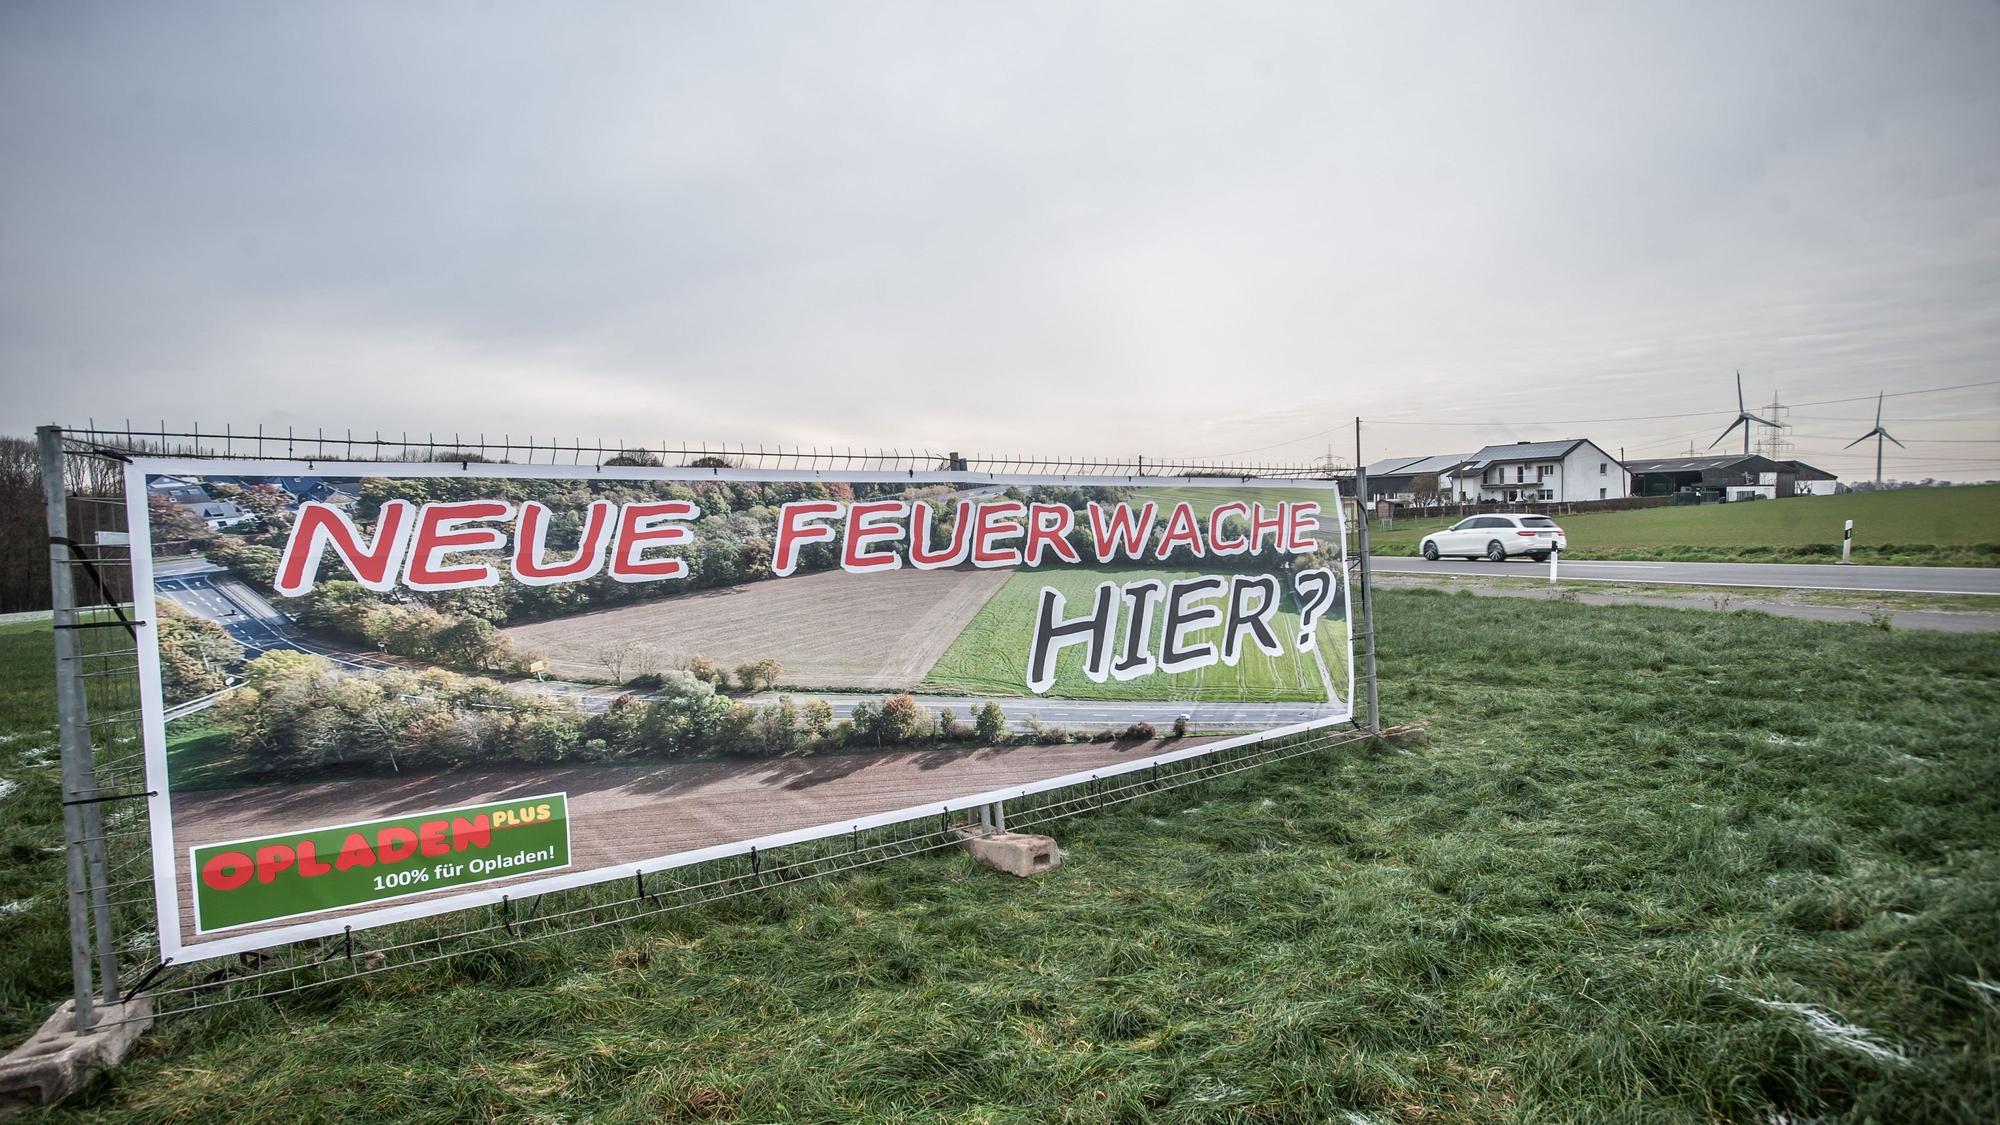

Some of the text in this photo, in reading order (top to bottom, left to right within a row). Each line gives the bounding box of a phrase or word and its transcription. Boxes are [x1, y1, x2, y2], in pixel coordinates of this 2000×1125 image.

[275, 499, 1321, 597] NEUE FEUERWACHE
[1027, 567, 1338, 694] HIER?
[203, 804, 551, 890] OPLADEN PLUS
[373, 845, 555, 891] 100% für Opladen!
